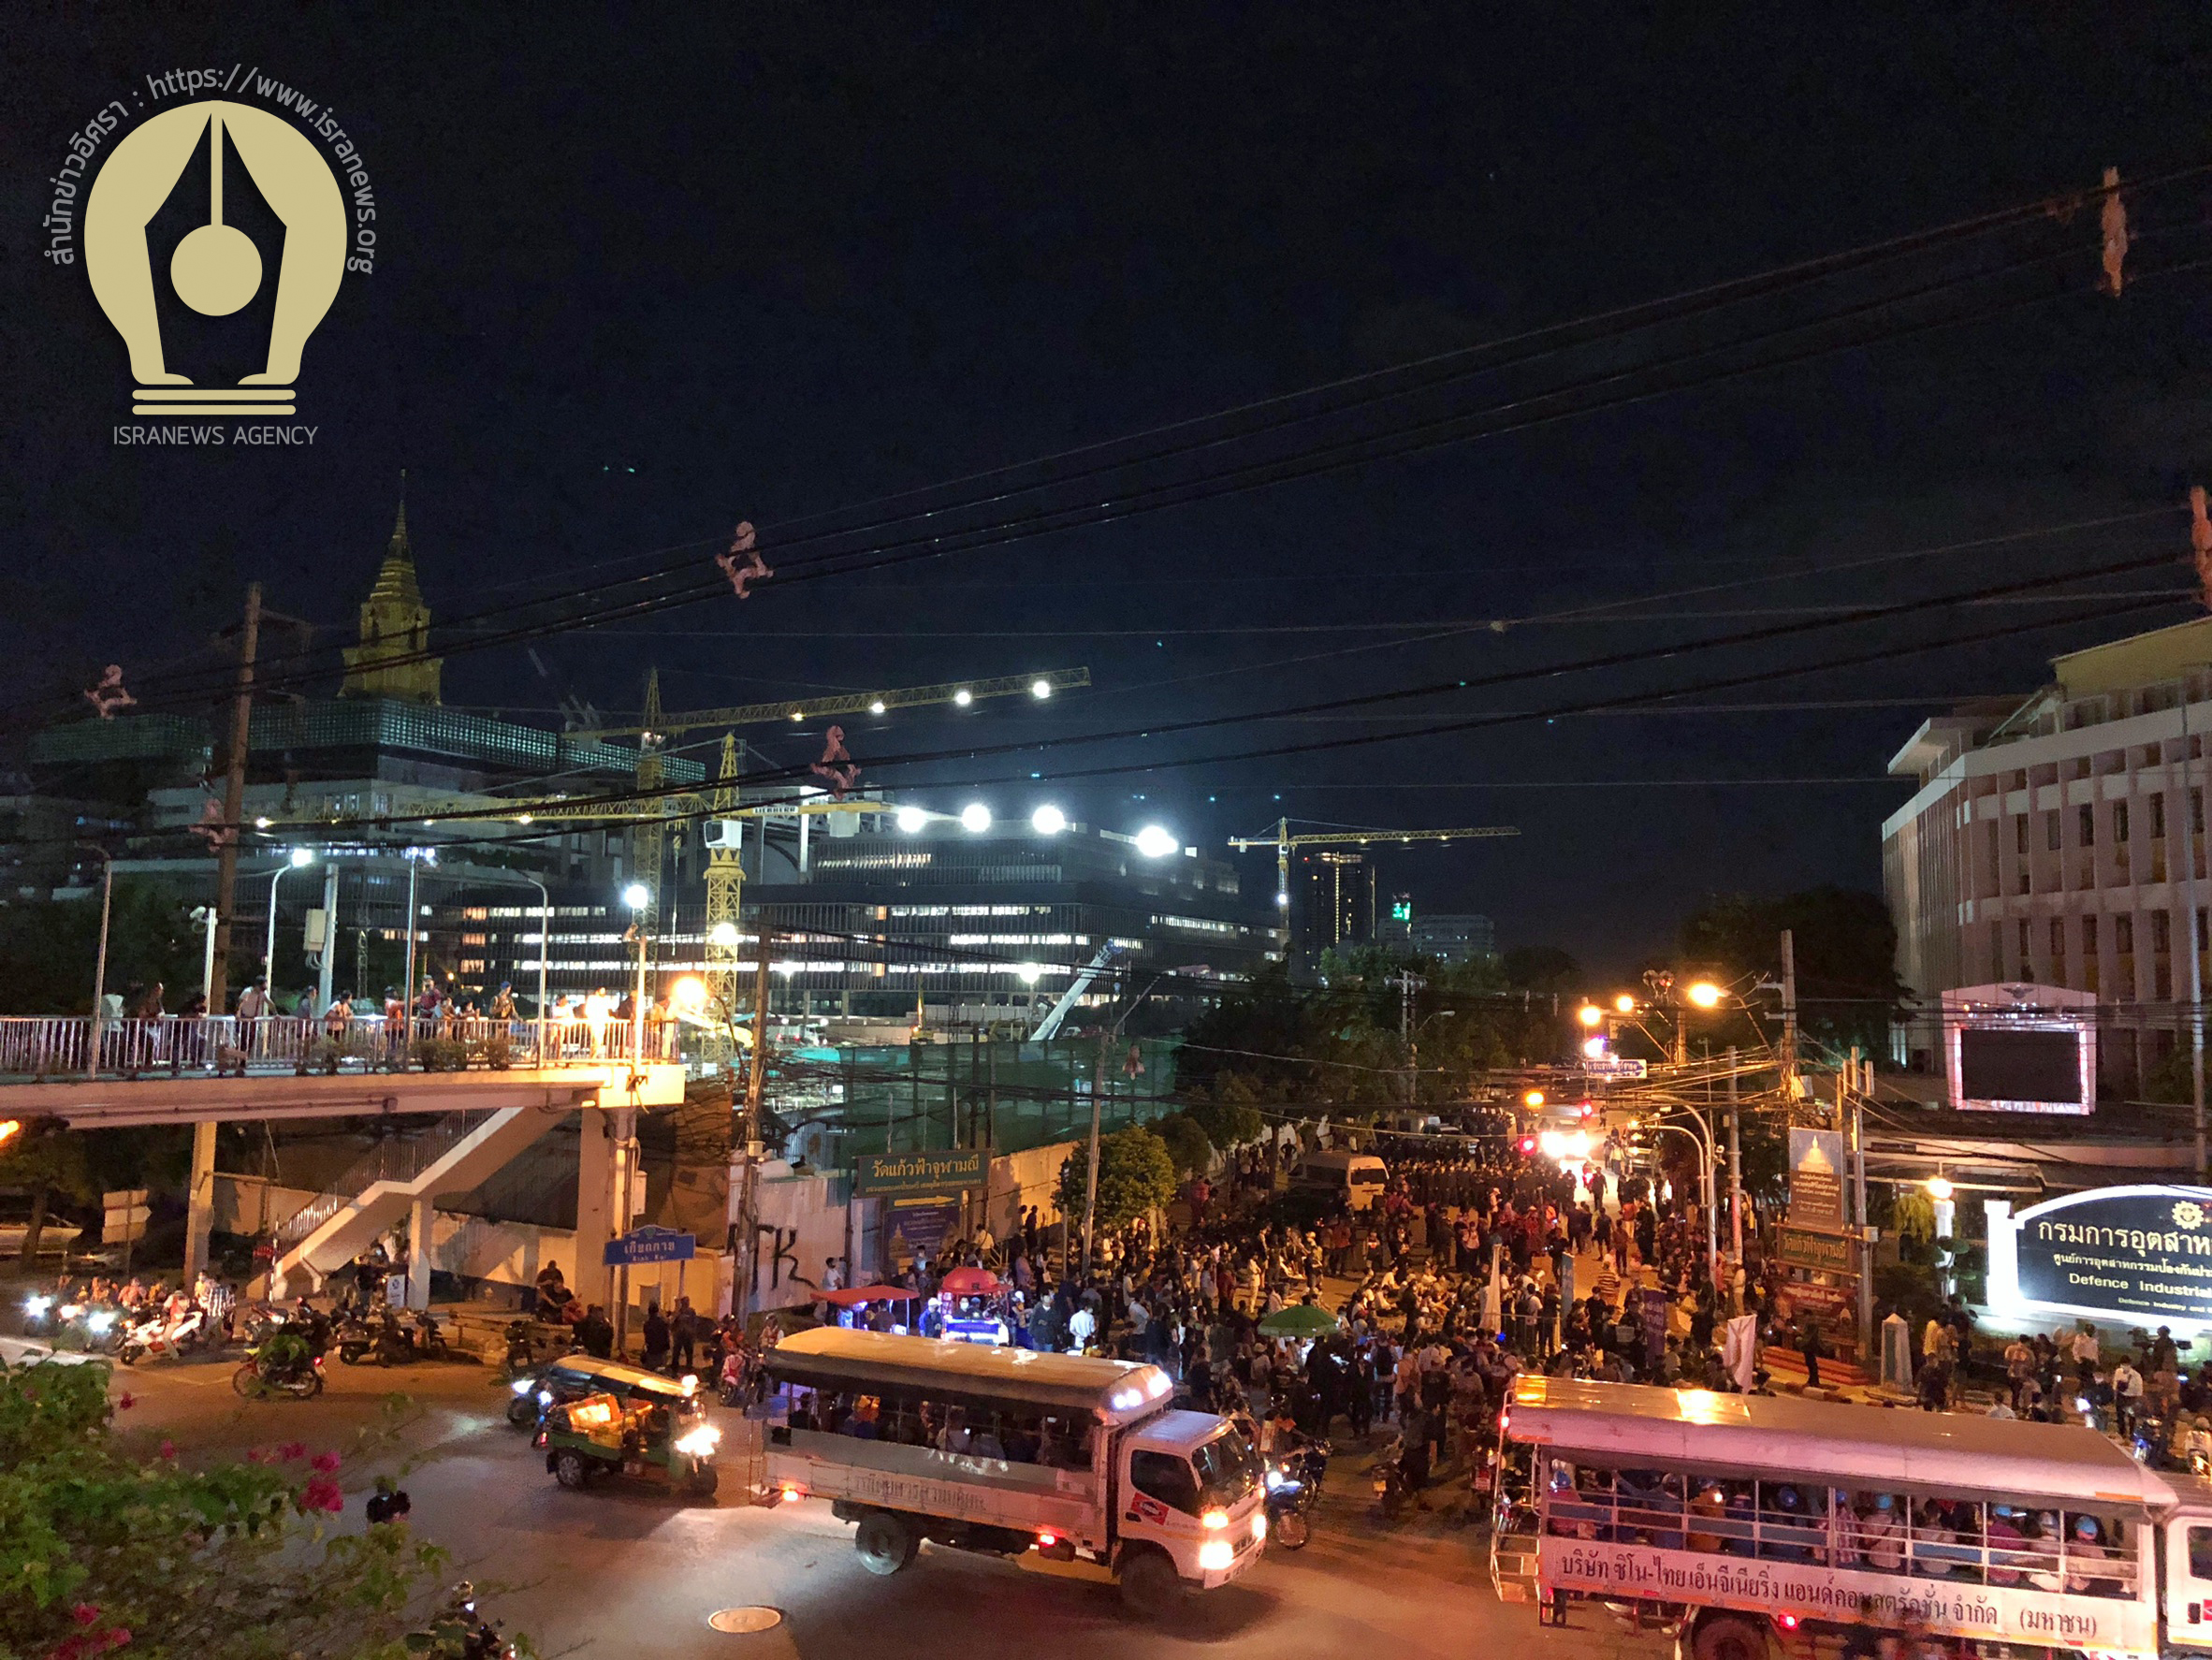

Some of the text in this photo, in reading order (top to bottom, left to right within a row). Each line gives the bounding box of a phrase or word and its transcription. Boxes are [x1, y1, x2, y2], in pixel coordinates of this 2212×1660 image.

[871, 1154, 980, 1180] วัดแก้วฟ้าจุฬามณี
[623, 1241, 676, 1255] เกียกกาย
[2038, 1221, 2212, 1257] กรมการอุตสาห
[2069, 1273, 2129, 1289] Defence
[1562, 1548, 1608, 1579] บริษัท
[1613, 1553, 1685, 1588] ซิโน-ไทย
[1952, 1594, 1998, 1625] จำกัด
[2019, 1607, 2098, 1638] (มหาชน)
